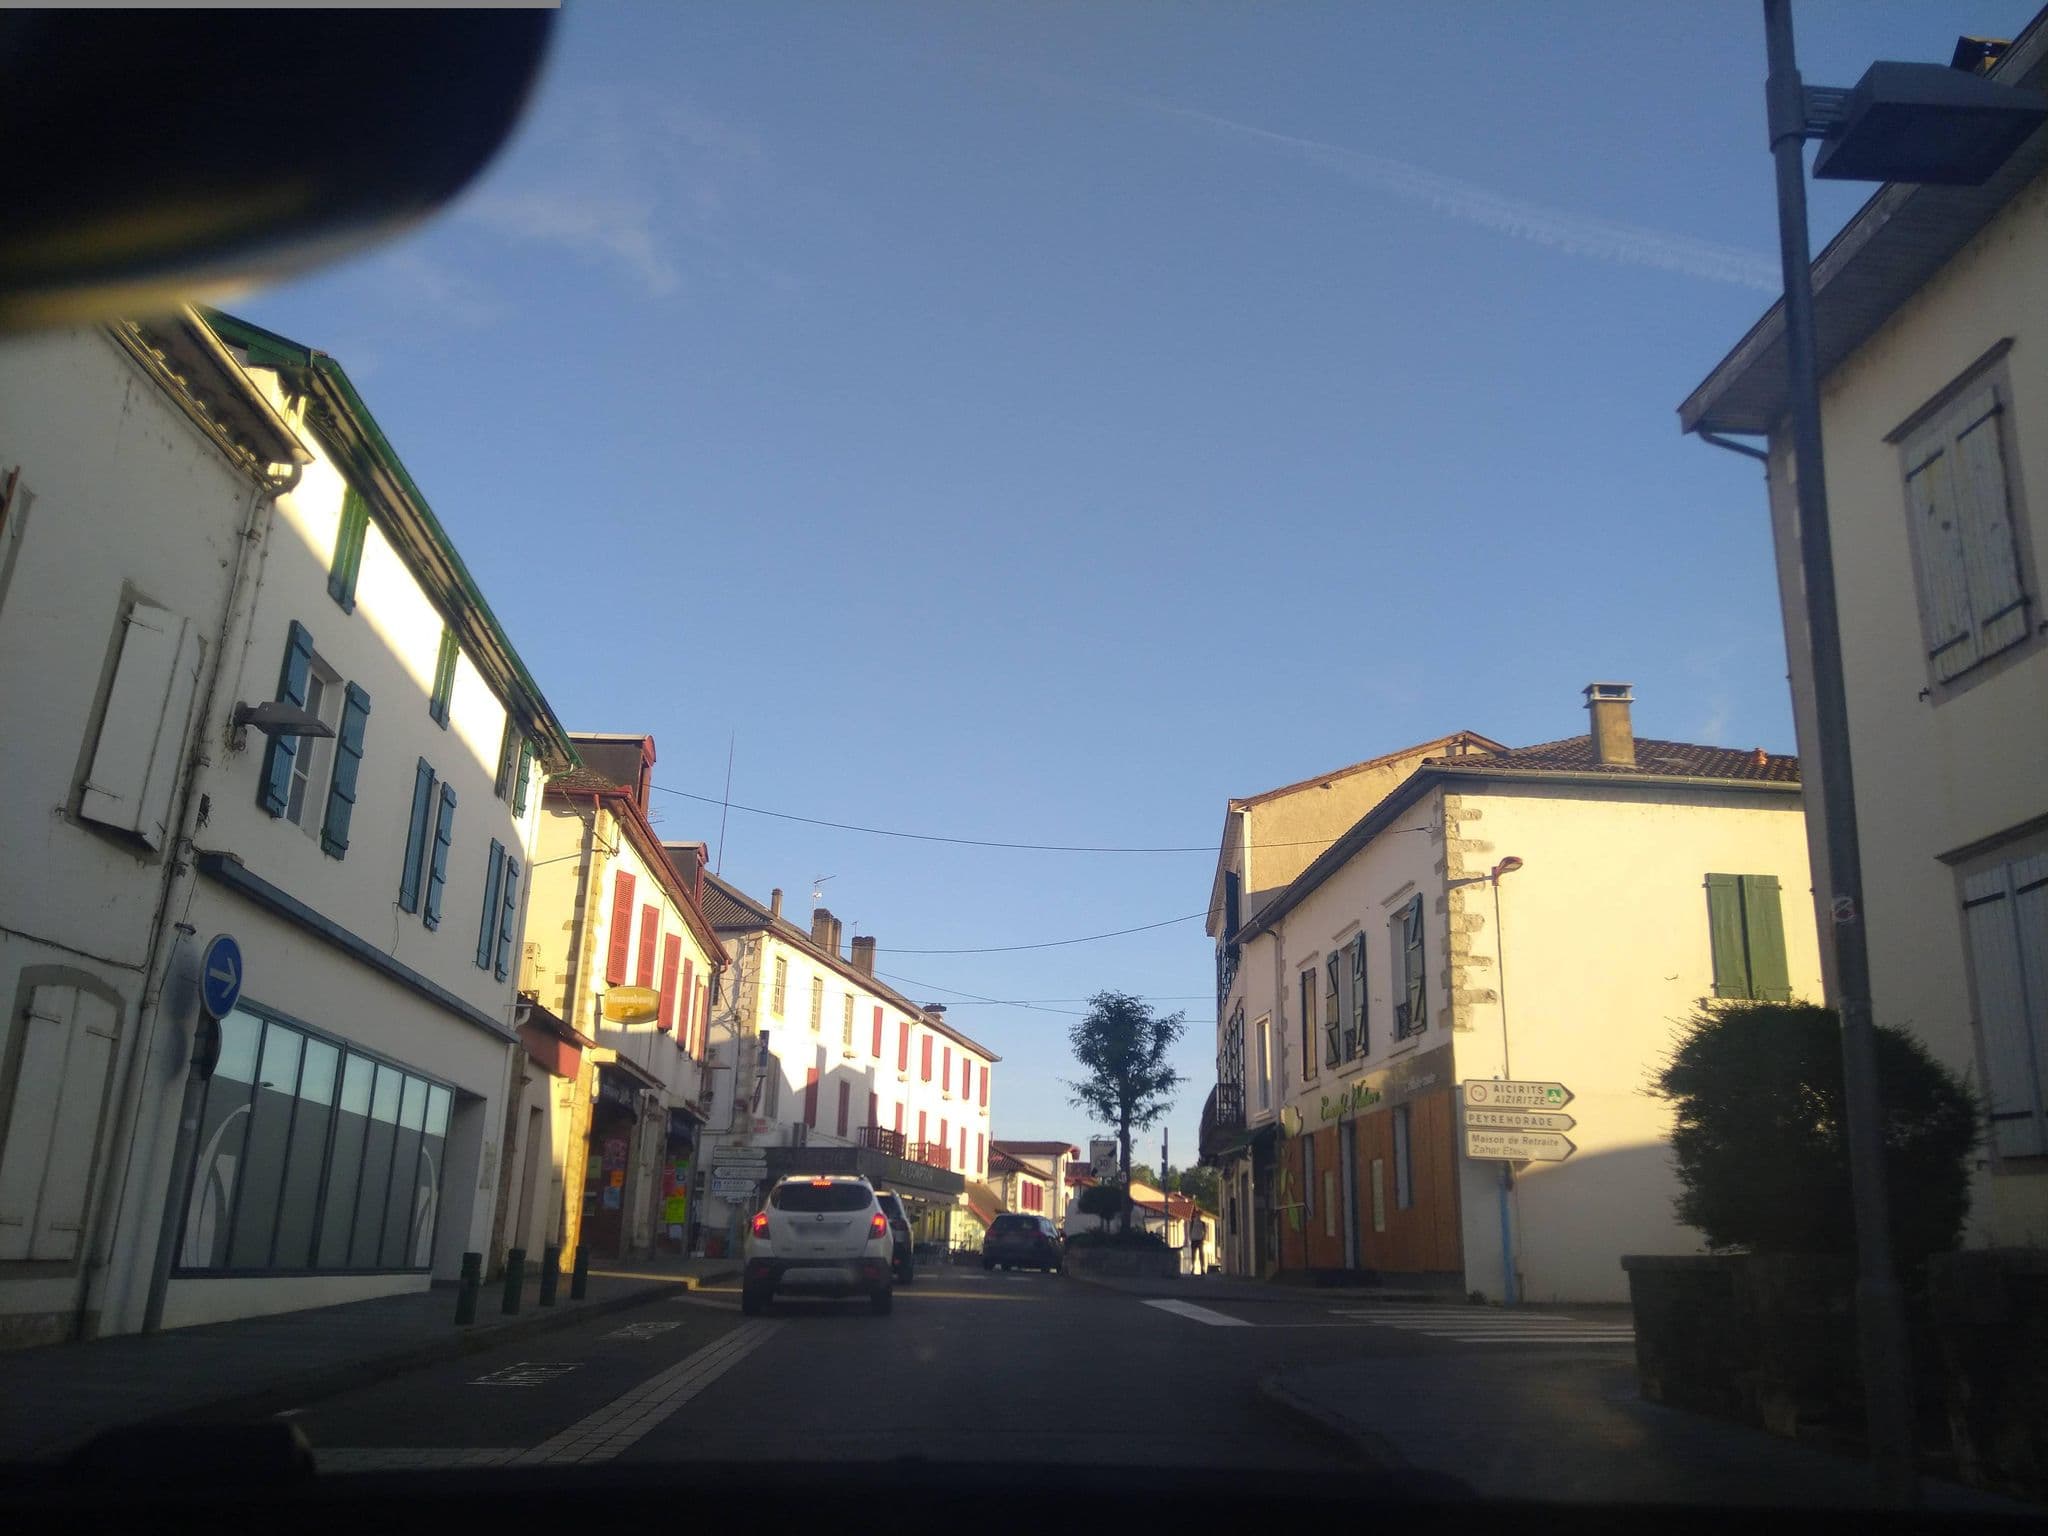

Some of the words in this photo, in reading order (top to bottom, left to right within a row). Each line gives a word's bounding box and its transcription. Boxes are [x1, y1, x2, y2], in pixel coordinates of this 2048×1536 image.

[1494, 1085, 1544, 1095] AICIRITS
[1468, 1114, 1552, 1126] PEYREHORADE
[1471, 1134, 1505, 1144] Maison
[1508, 1135, 1519, 1145] de
[1522, 1136, 1559, 1147] Retraite
